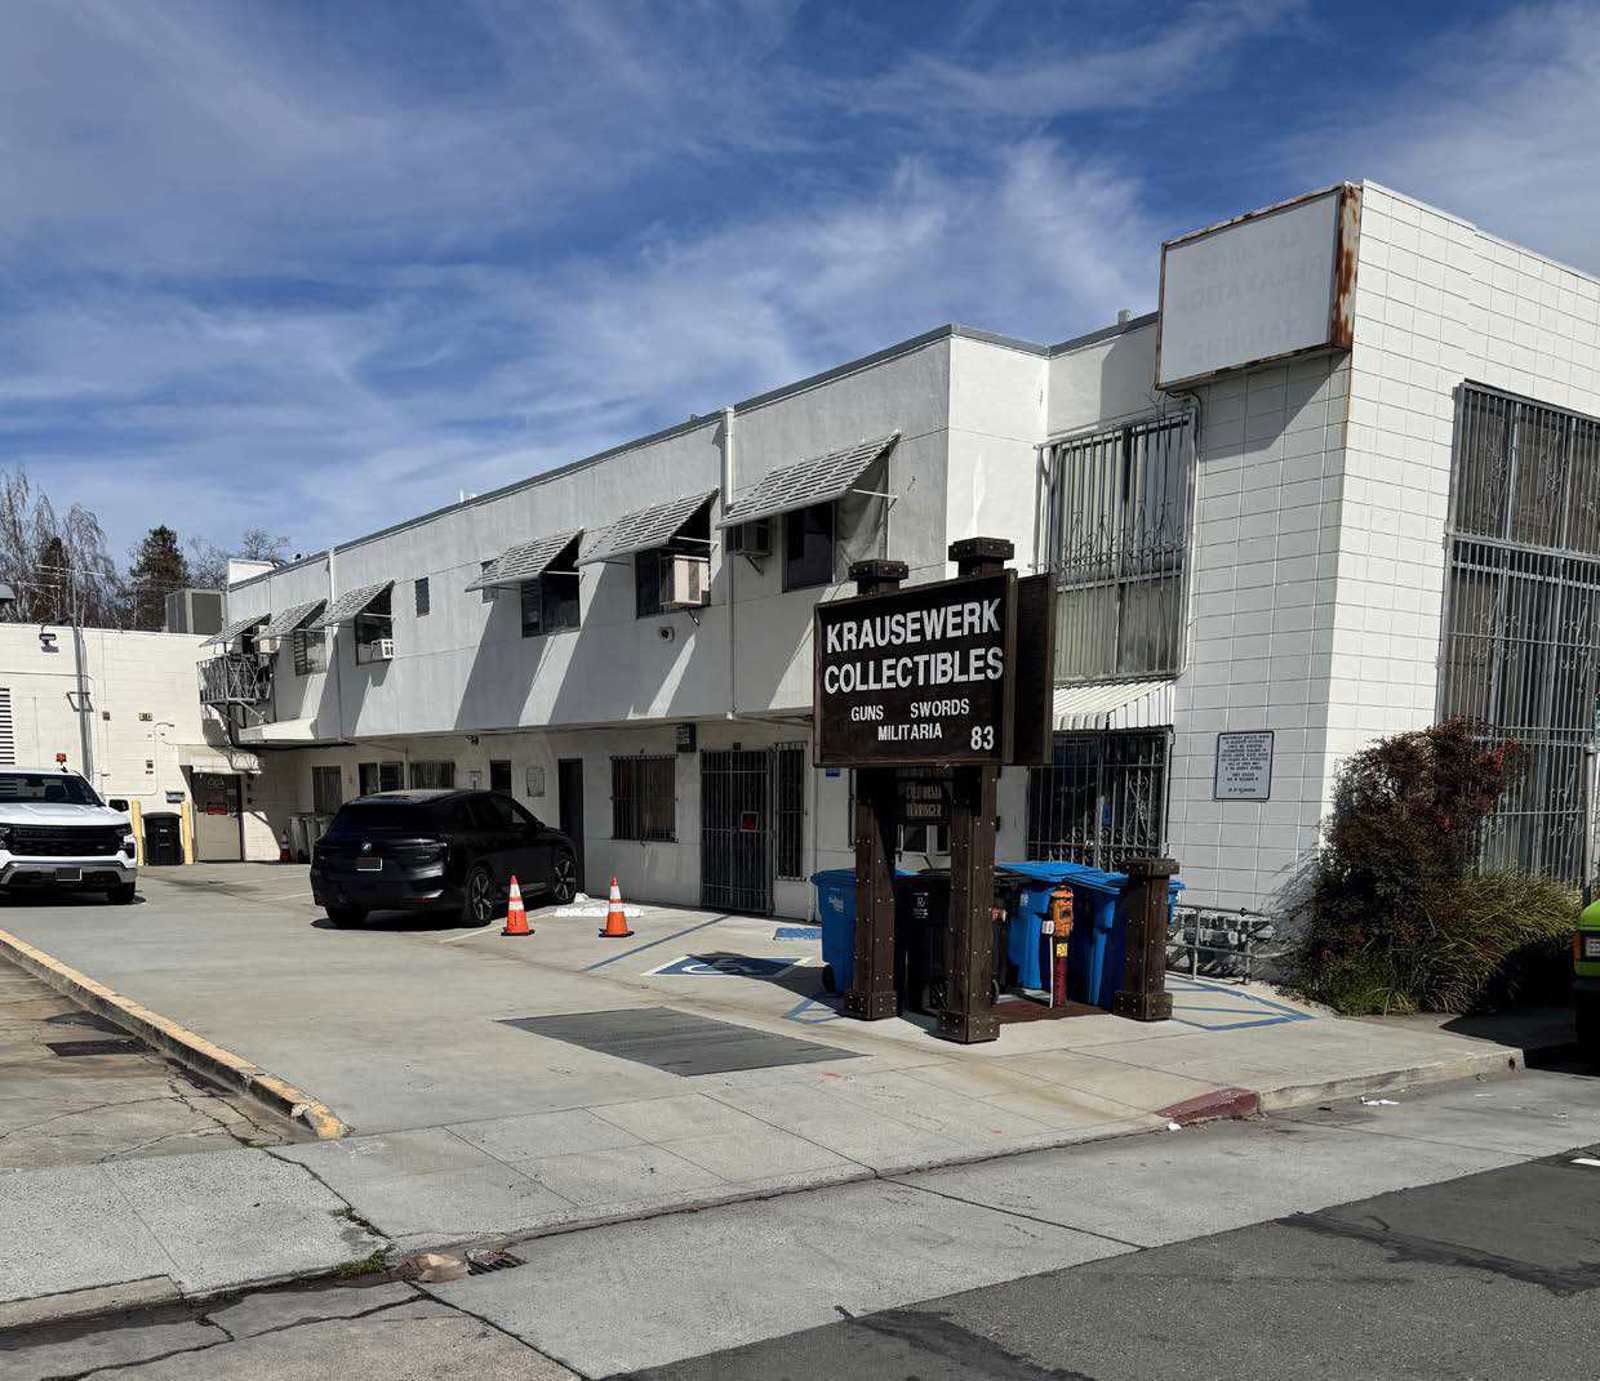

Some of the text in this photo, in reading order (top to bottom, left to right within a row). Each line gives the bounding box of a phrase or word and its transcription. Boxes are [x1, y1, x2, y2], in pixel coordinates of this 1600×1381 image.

[826, 598, 1001, 654] KRAUSEWERK
[823, 646, 1004, 695] COLLECTIBLES
[850, 698, 971, 722] GUNS SWORDS
[877, 723, 943, 742] MILITARIA
[970, 726, 995, 751] 83
